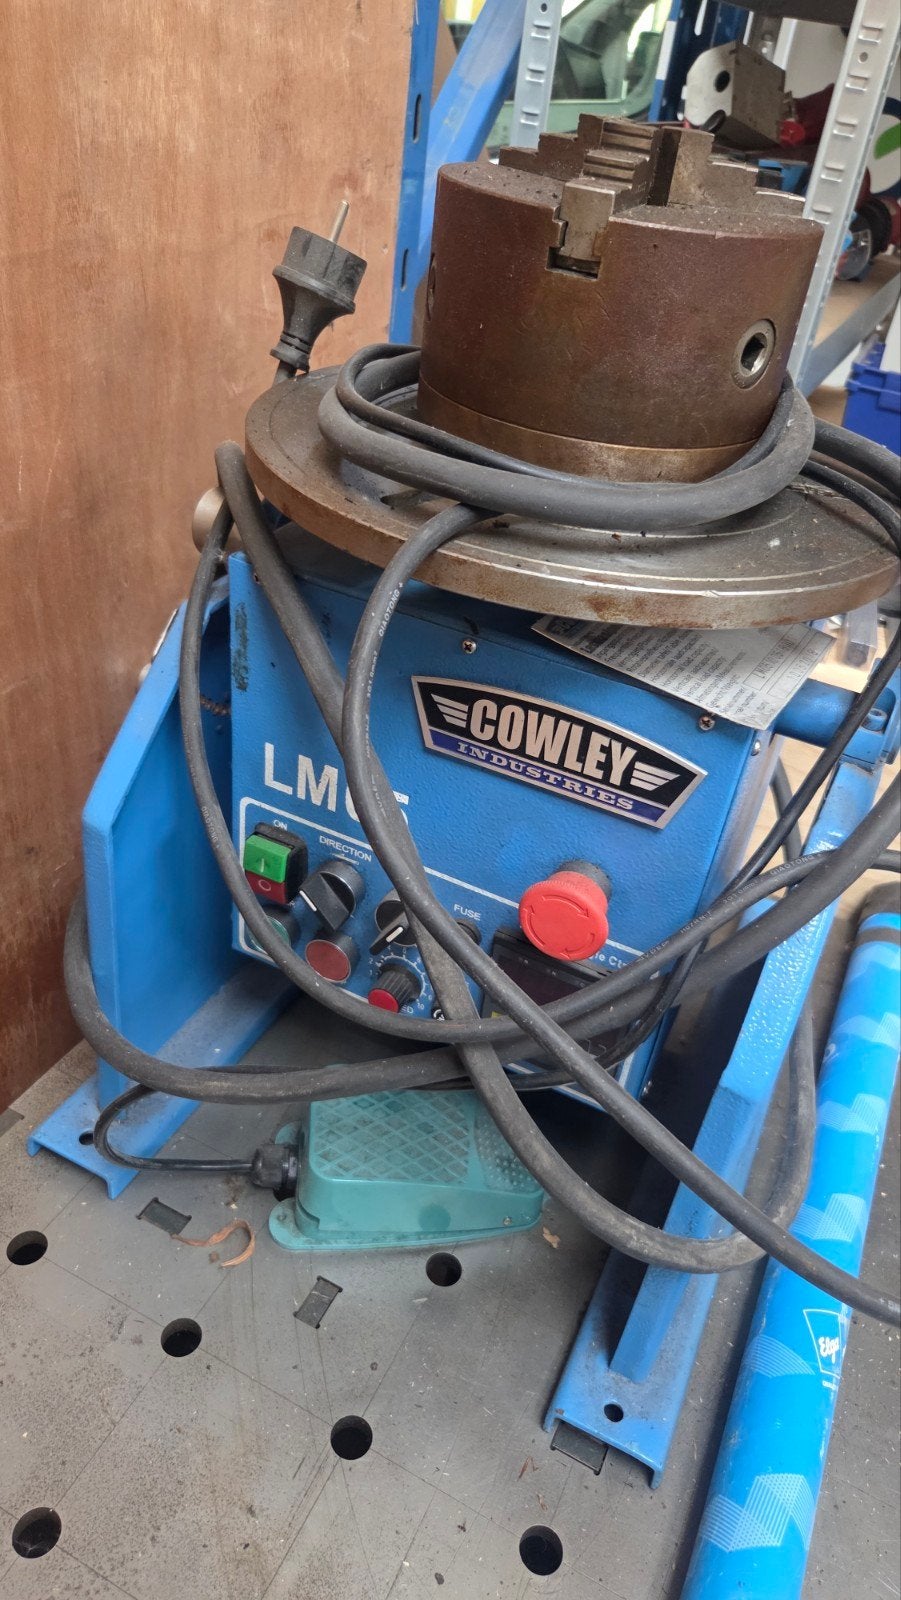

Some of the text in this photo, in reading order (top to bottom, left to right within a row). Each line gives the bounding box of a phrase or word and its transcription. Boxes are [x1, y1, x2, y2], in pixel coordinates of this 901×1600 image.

[470, 699, 638, 786] COWLEY
[457, 742, 633, 811] INDUSTRIES
[273, 820, 288, 831] ON
[319, 835, 372, 862] DIRECTION
[454, 903, 482, 921] FUSE
